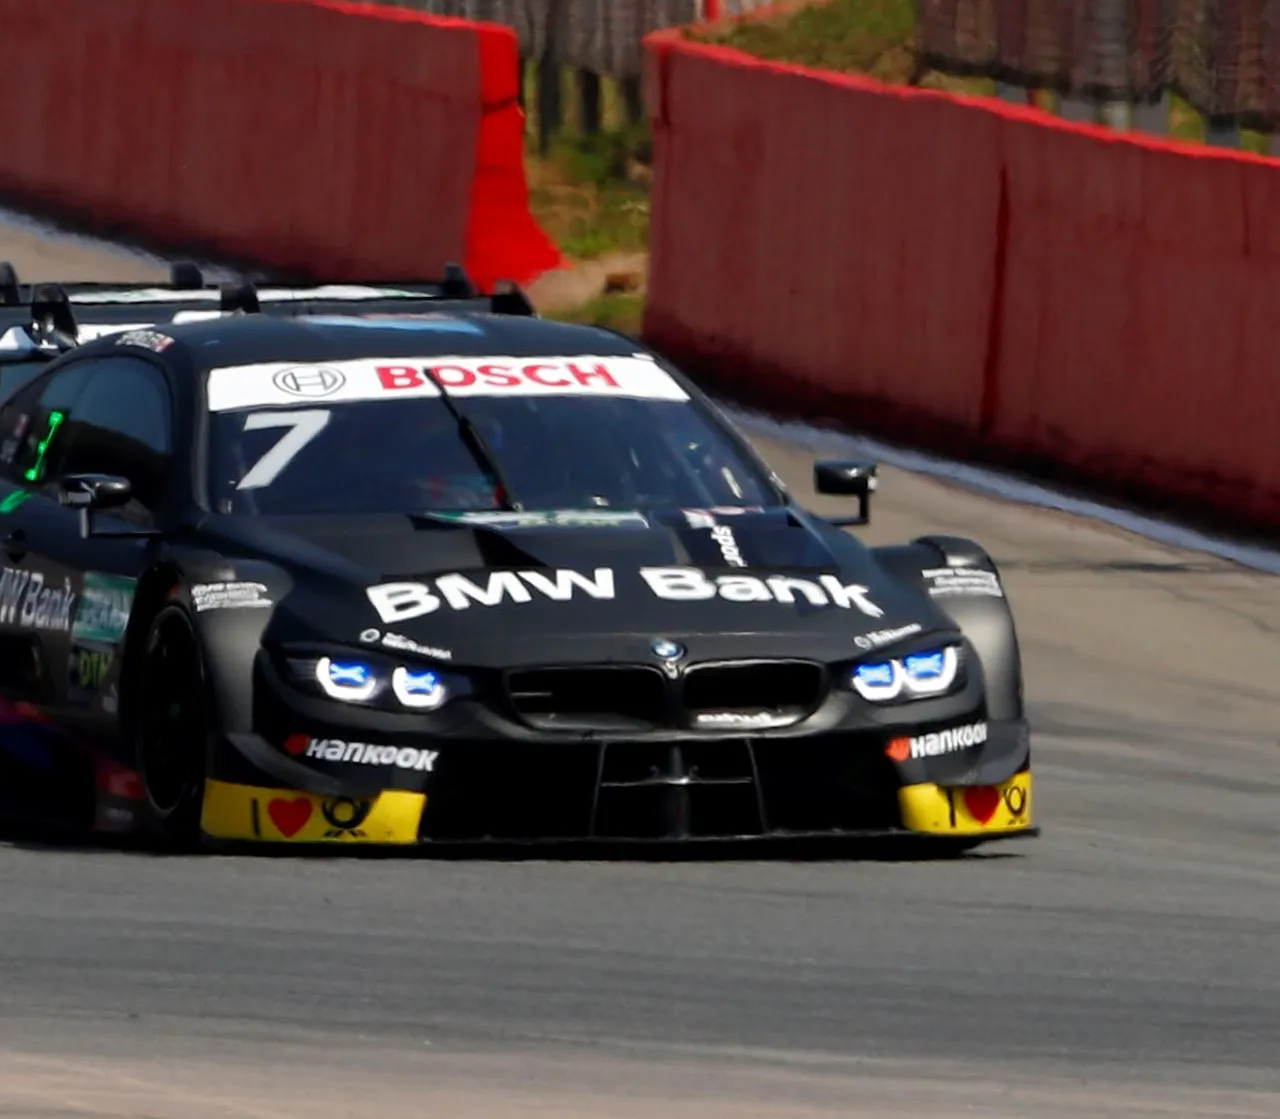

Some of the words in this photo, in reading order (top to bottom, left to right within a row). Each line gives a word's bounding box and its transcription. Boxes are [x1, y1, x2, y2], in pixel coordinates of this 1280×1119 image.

[376, 363, 622, 391] BOSCH
[236, 409, 333, 490] 7
[19, 572, 76, 631] Bank
[366, 567, 617, 624] BMW
[639, 565, 885, 619] Bank
